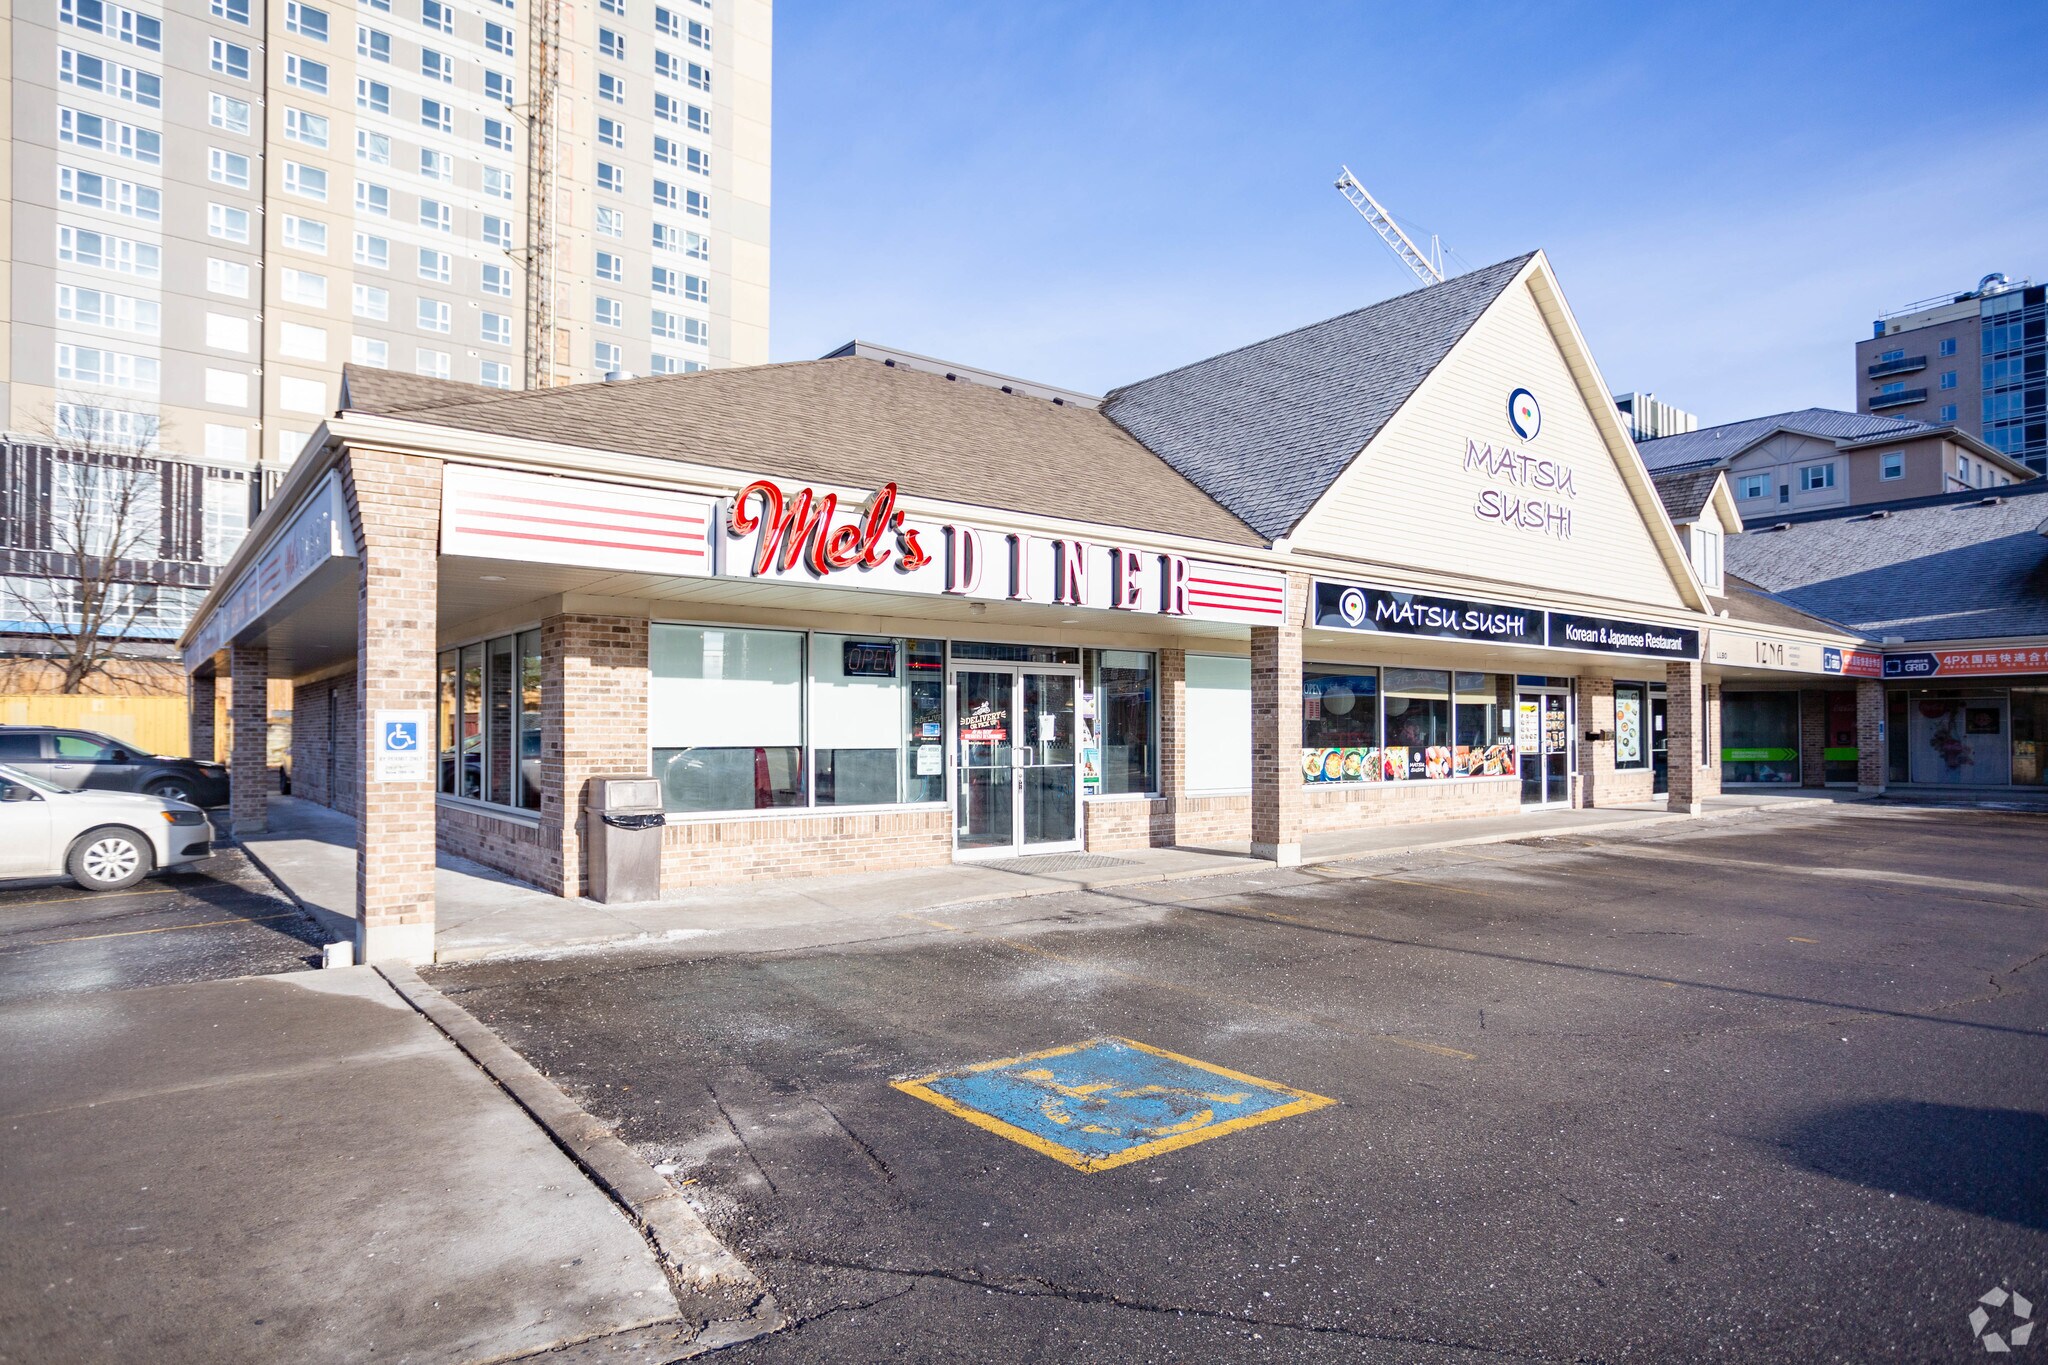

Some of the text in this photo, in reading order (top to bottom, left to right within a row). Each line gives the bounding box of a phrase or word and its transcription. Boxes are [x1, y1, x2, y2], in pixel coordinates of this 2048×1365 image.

[1465, 438, 1576, 496] MATSU
[1475, 490, 1572, 537] SUSHI
[730, 480, 1192, 616] Mel's DINER
[1375, 599, 1524, 637] MATSU SUSHI
[1565, 623, 1683, 650] Korean & Japanese Restaurant
[848, 648, 896, 672] OPEN
[1716, 651, 1728, 659] LLBO
[1756, 641, 1784, 665] IZNA
[1943, 655, 1969, 665] 4PX
[1904, 664, 1930, 672] GRID
[1304, 683, 1322, 695] OPEN
[965, 711, 1001, 725] DELIVERY
